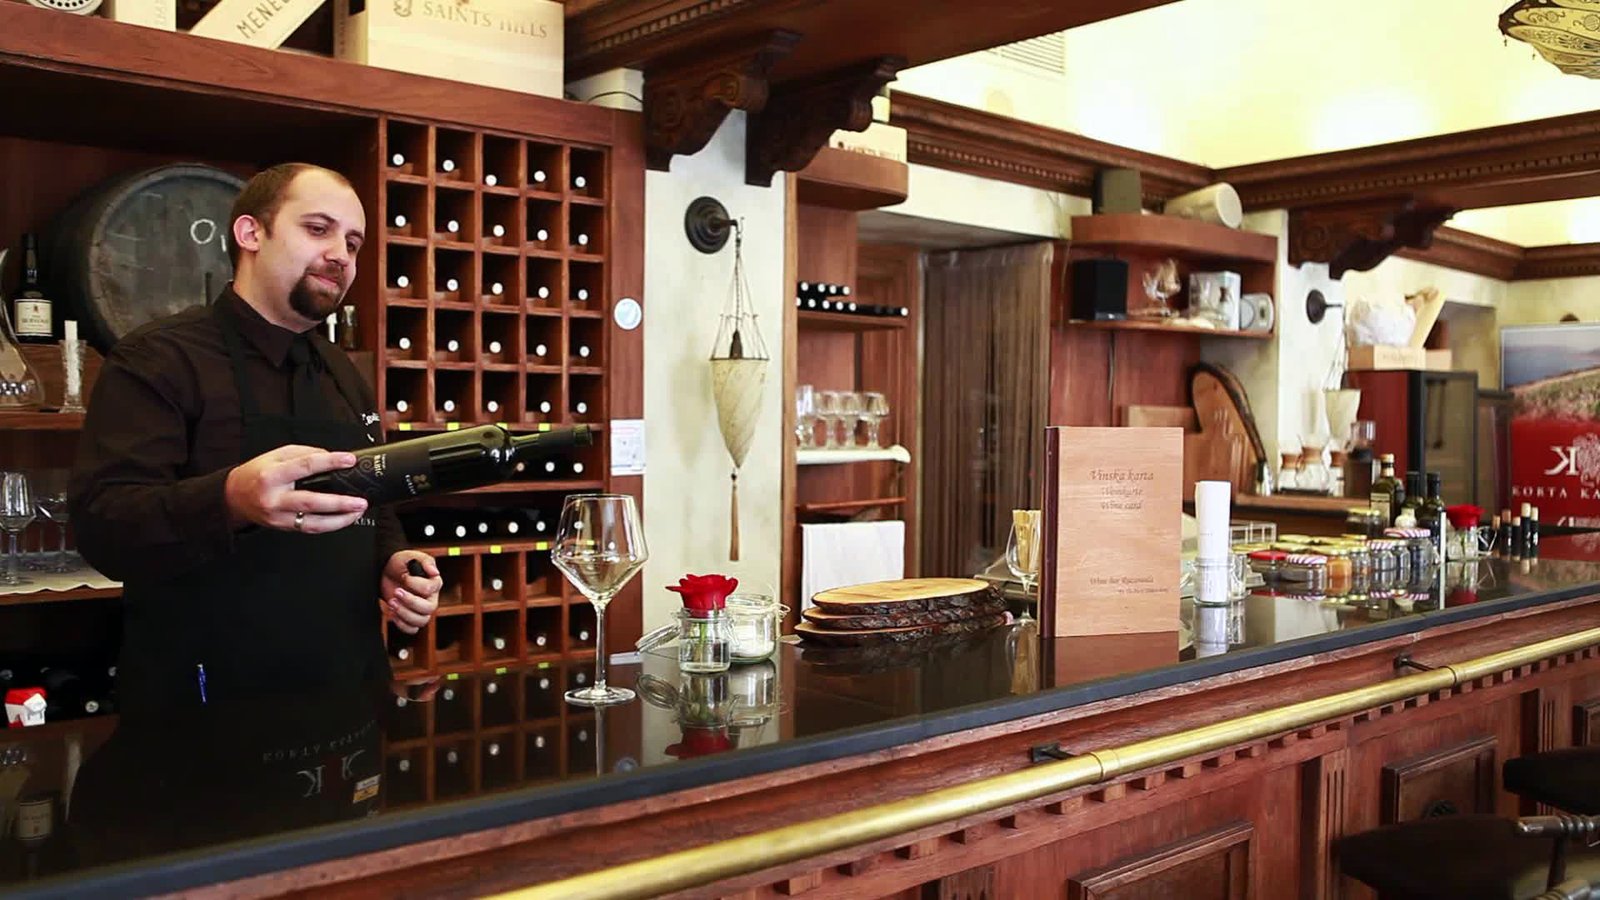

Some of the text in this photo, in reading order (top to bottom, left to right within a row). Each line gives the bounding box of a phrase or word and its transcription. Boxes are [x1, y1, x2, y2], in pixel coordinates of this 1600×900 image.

[236, 0, 290, 39] MENE
[423, 1, 492, 27] SAINTS
[1512, 486, 1567, 499] KORTA
